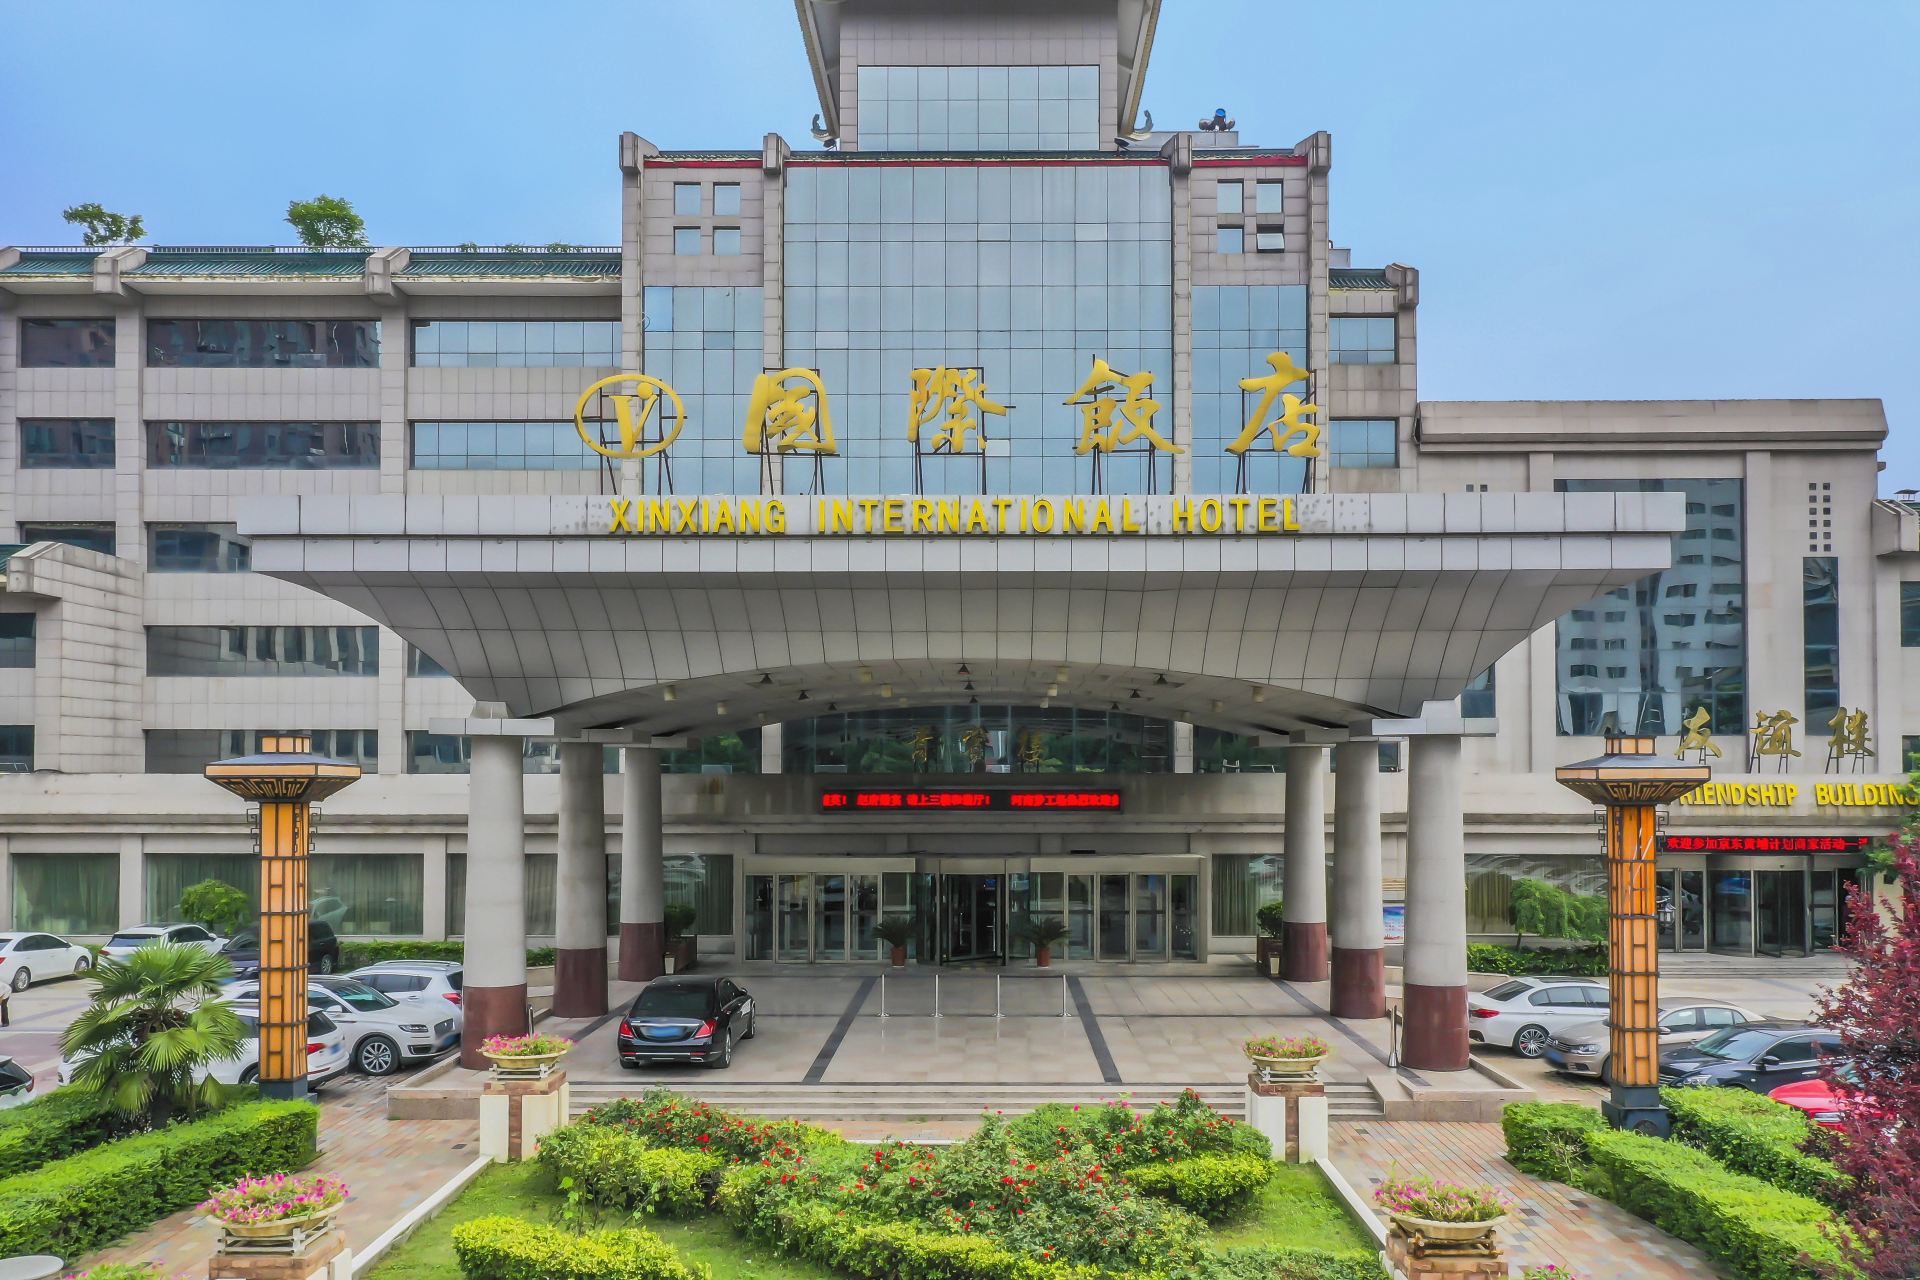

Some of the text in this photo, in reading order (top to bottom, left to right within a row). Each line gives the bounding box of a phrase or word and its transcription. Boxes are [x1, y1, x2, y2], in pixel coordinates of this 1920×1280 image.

[610, 498, 1301, 534] XINXIANG INTERNATIONAL HOTEL
